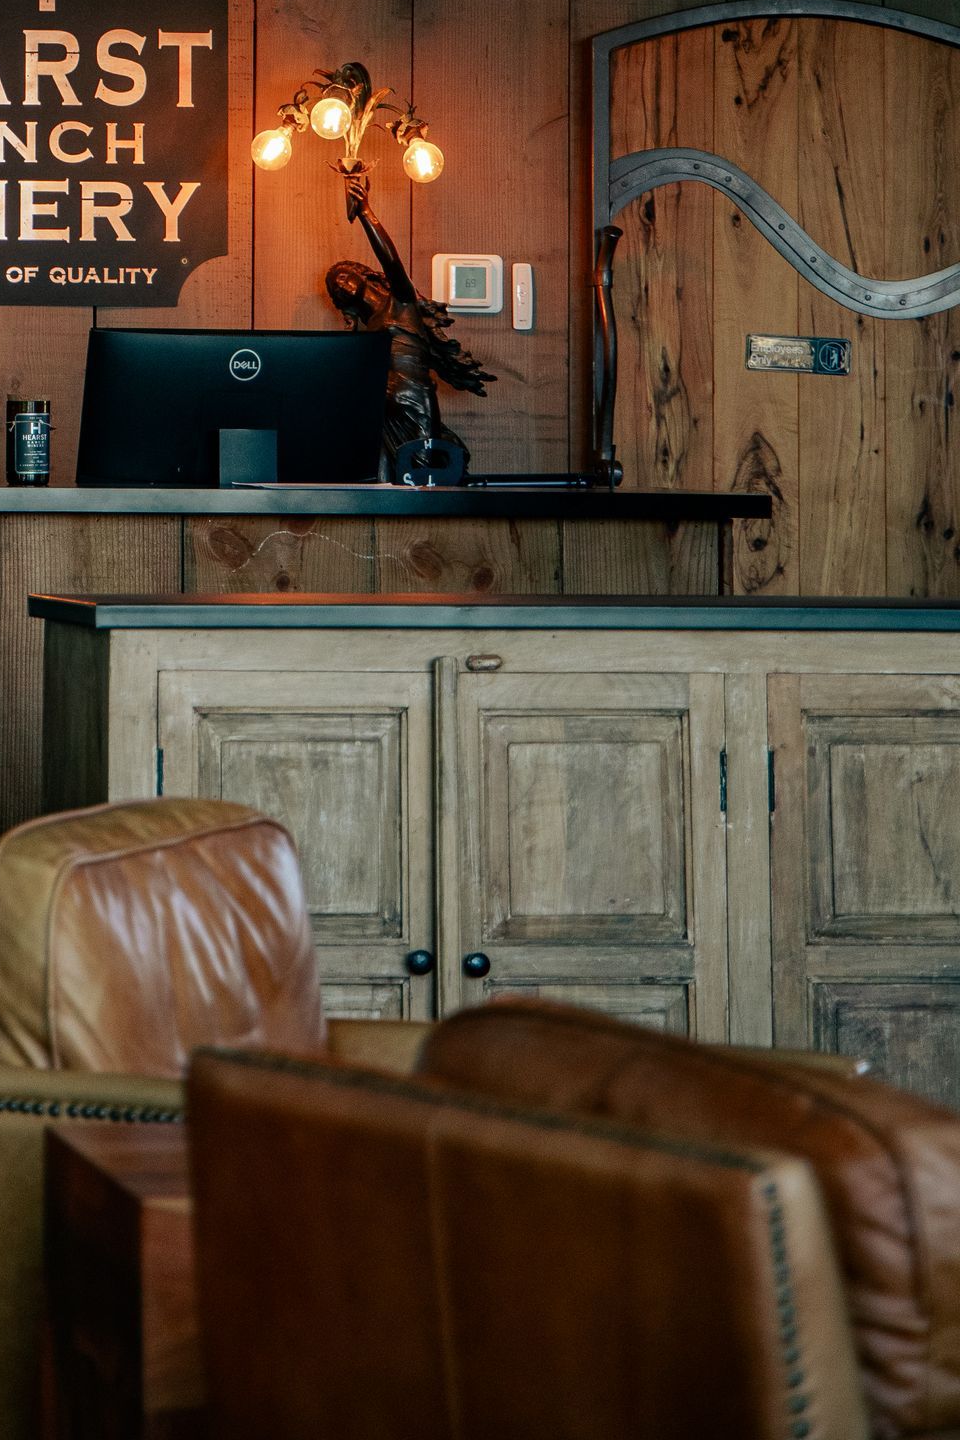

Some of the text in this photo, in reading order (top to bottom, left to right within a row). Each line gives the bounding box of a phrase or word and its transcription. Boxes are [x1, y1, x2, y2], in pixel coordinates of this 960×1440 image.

[5, 266, 39, 284] OF
[48, 266, 158, 286] QUALITY
[233, 360, 258, 370] DELL
